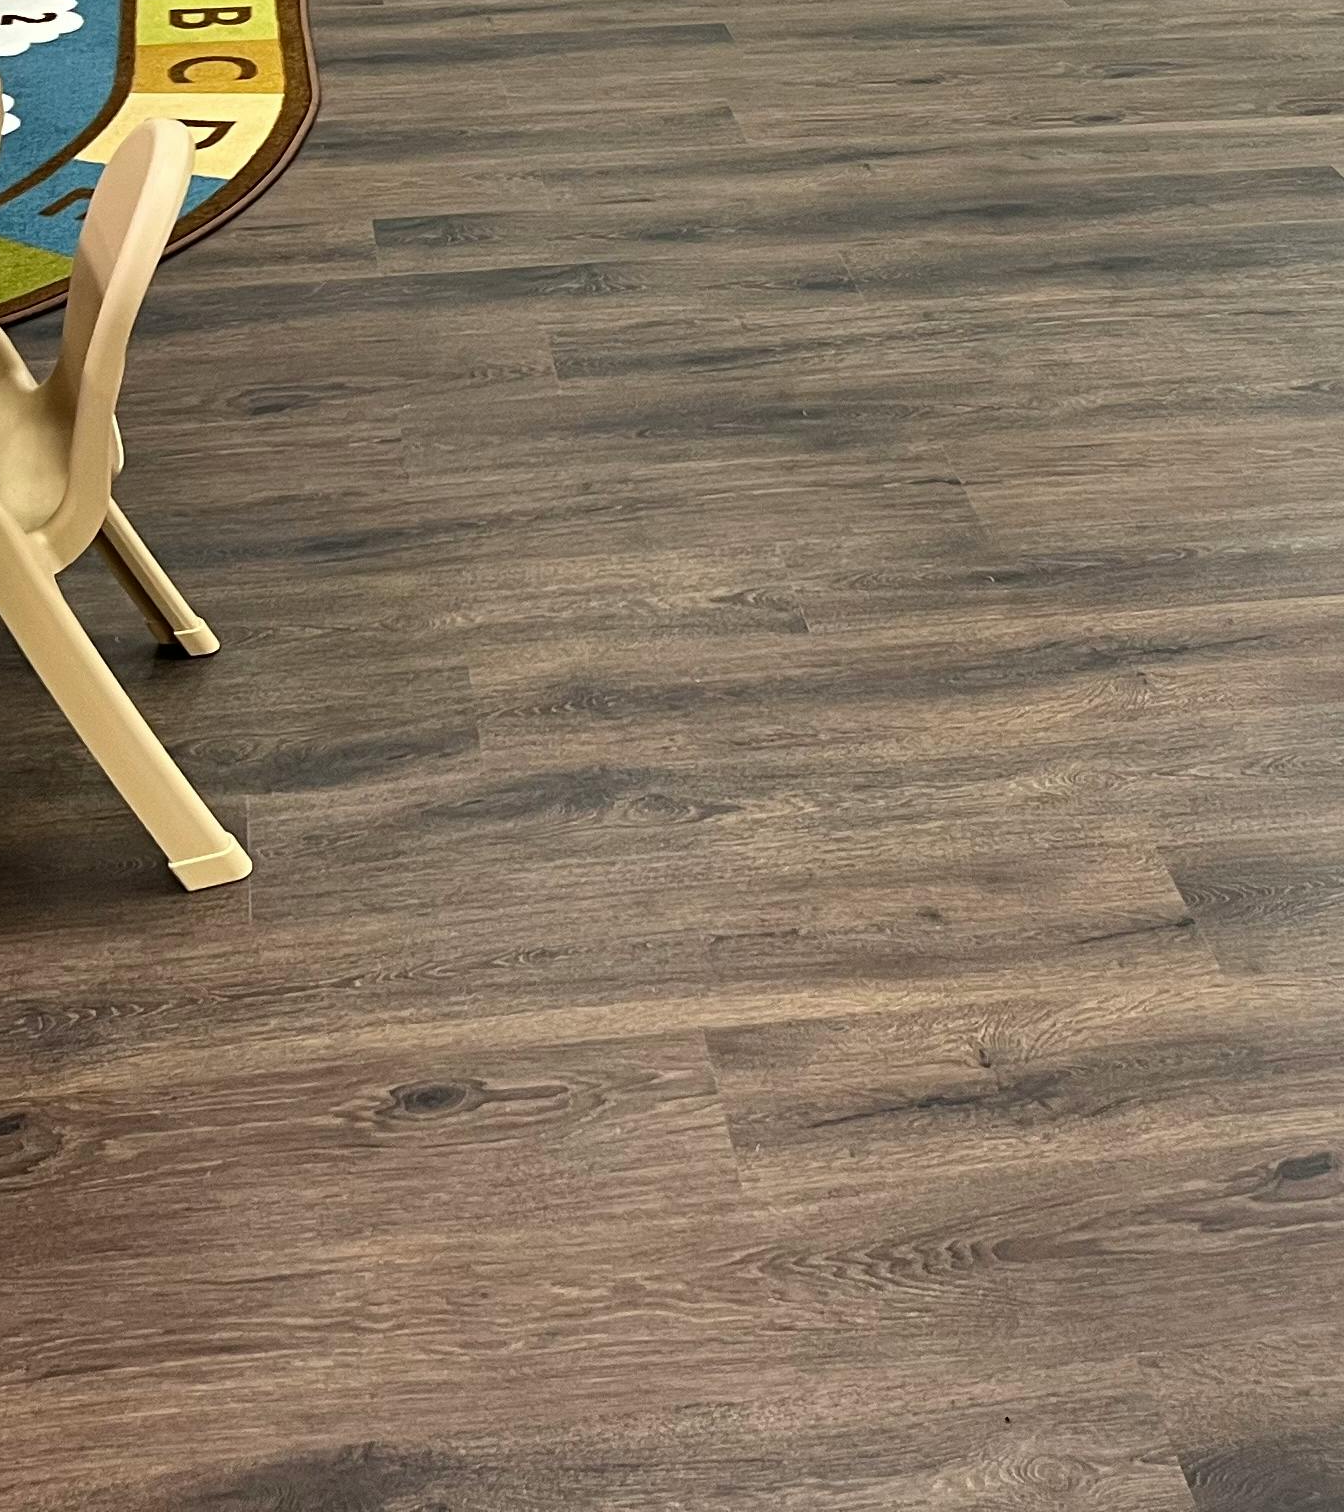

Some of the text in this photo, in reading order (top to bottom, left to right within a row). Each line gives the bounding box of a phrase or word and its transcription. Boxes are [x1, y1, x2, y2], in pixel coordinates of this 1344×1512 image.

[0, 11, 58, 27] 2
[169, 6, 253, 30] B
[167, 55, 259, 85] C
